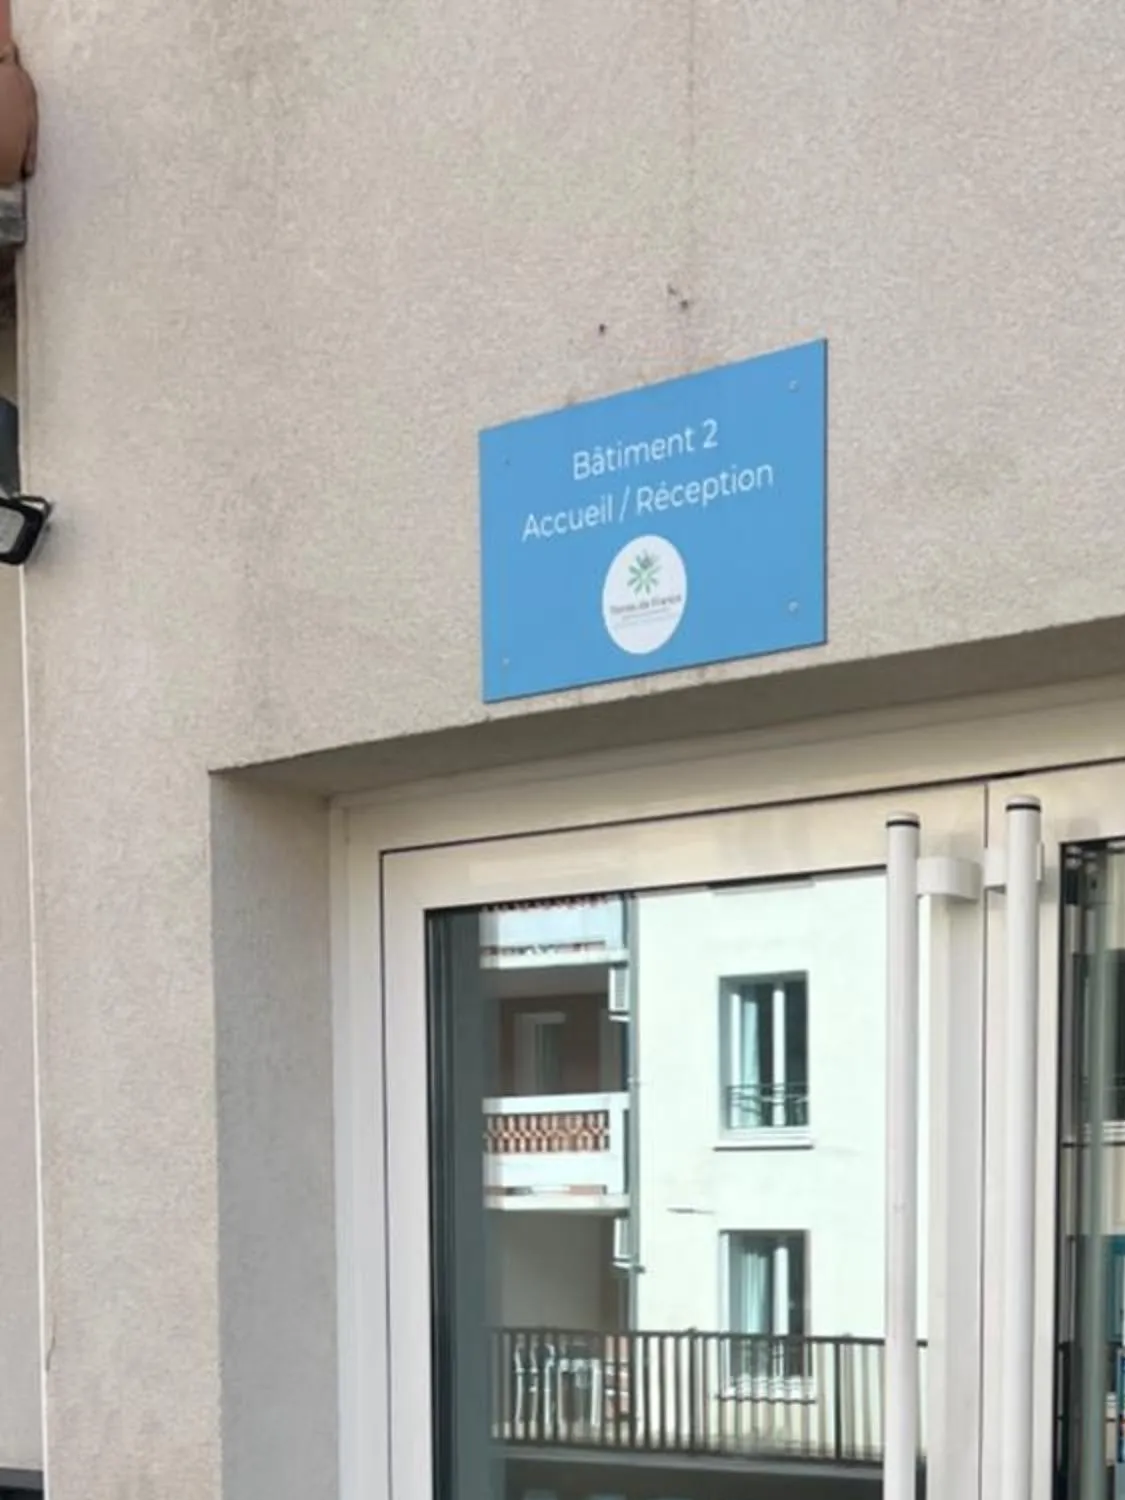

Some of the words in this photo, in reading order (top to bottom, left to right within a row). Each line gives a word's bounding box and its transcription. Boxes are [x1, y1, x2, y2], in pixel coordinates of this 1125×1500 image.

[572, 428, 695, 481] Bâtiment
[702, 418, 719, 450] 2
[521, 495, 614, 543] Accueil
[635, 462, 775, 516] Réception
